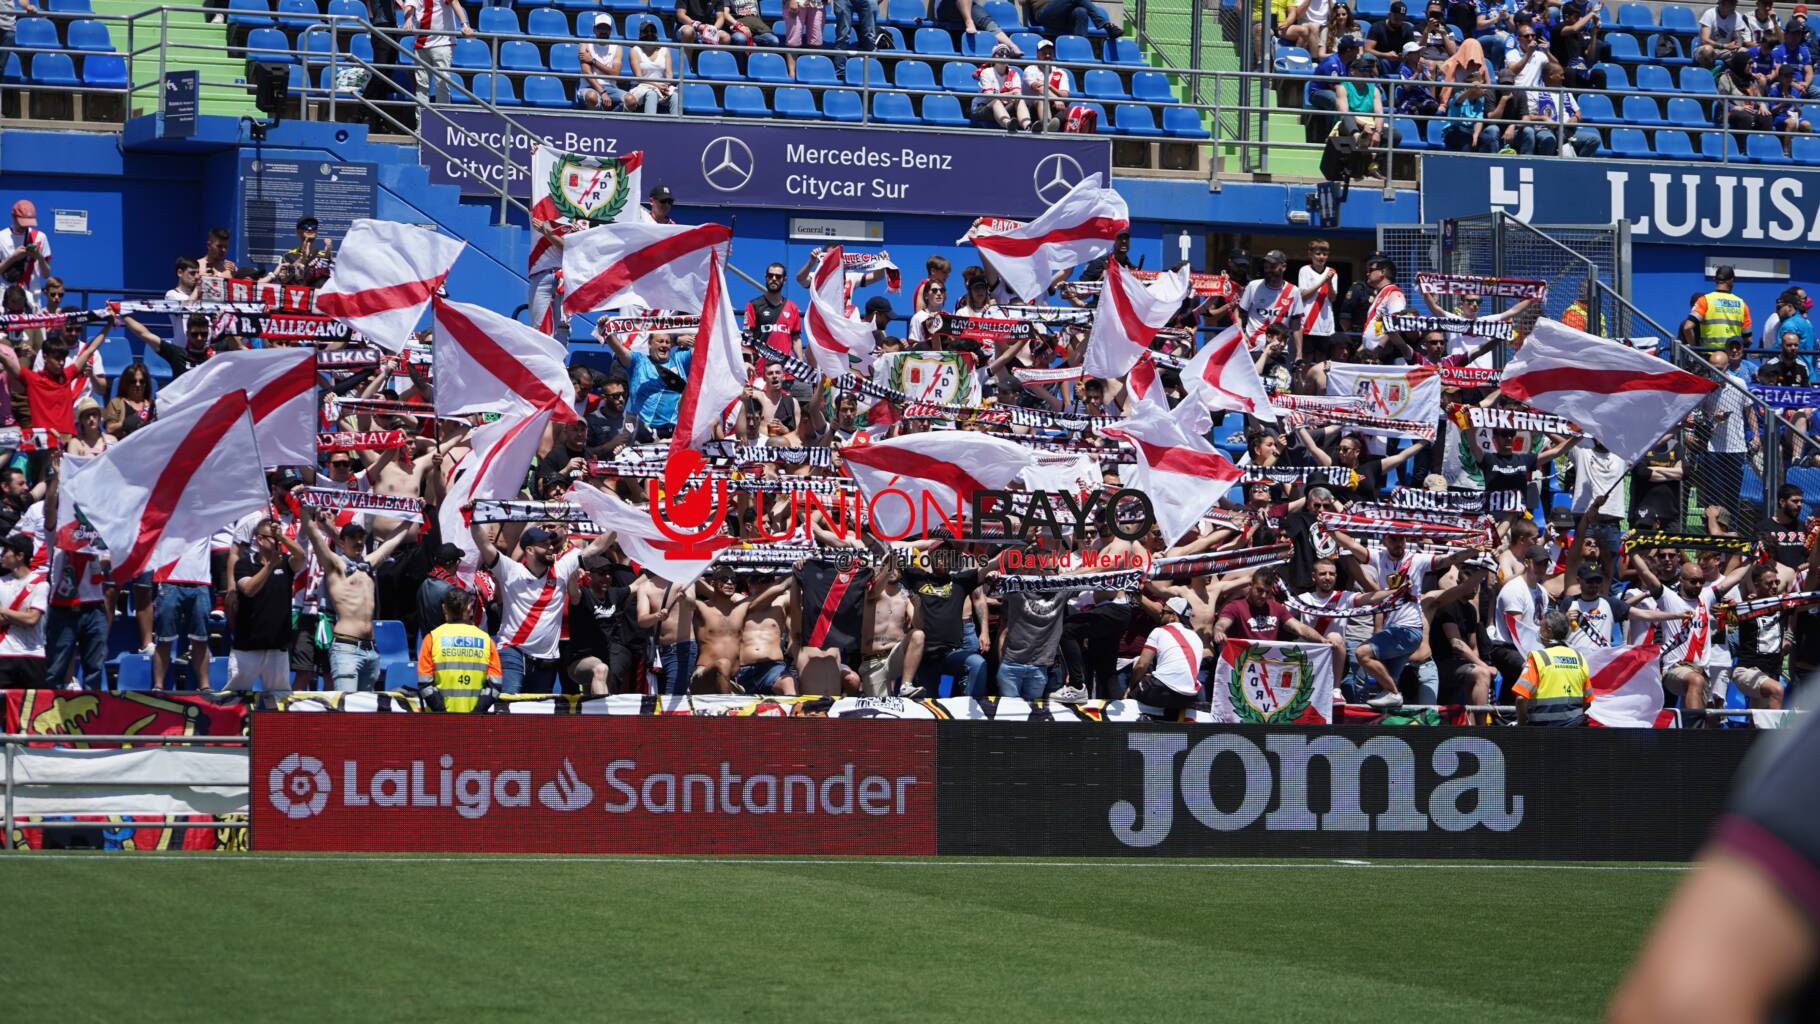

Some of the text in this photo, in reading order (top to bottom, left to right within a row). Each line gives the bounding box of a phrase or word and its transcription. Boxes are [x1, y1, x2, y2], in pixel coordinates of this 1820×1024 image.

[786, 143, 952, 170] Mercedes-Benz
[786, 174, 909, 200] Citycar Sur
[1606, 171, 1820, 242] LUJIS
[797, 226, 824, 234] General
[1421, 281, 1544, 299] DE PRIMERA!
[242, 317, 347, 338] R. VALLECANO
[654, 316, 701, 331] VALLE
[951, 318, 1031, 334] RAYO VALLECANO
[1451, 368, 1502, 381] VALLECAN
[1750, 388, 1811, 404] GETAFE
[441, 648, 484, 658] SEGURIDAD
[457, 674, 471, 686] 49
[1563, 684, 1572, 694] 14
[343, 753, 917, 819] LaLiga Santander
[1108, 733, 1524, 848] Joma
